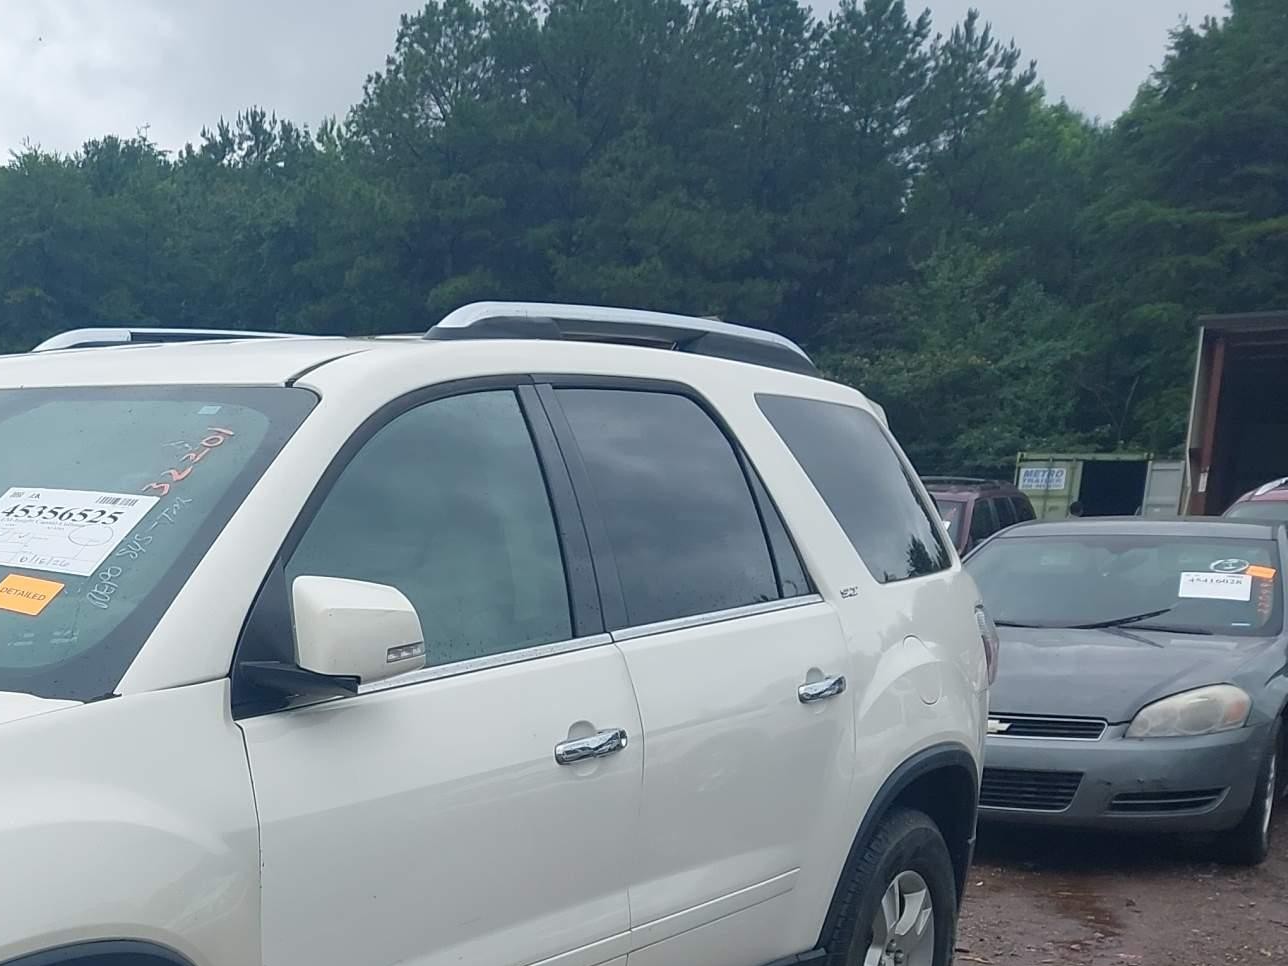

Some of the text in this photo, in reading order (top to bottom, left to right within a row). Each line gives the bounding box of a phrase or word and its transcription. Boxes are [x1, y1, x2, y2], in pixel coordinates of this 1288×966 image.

[1023, 469, 1065, 478] METRO
[1, 503, 125, 525] 45356525
[0, 586, 47, 602] DETAILED
